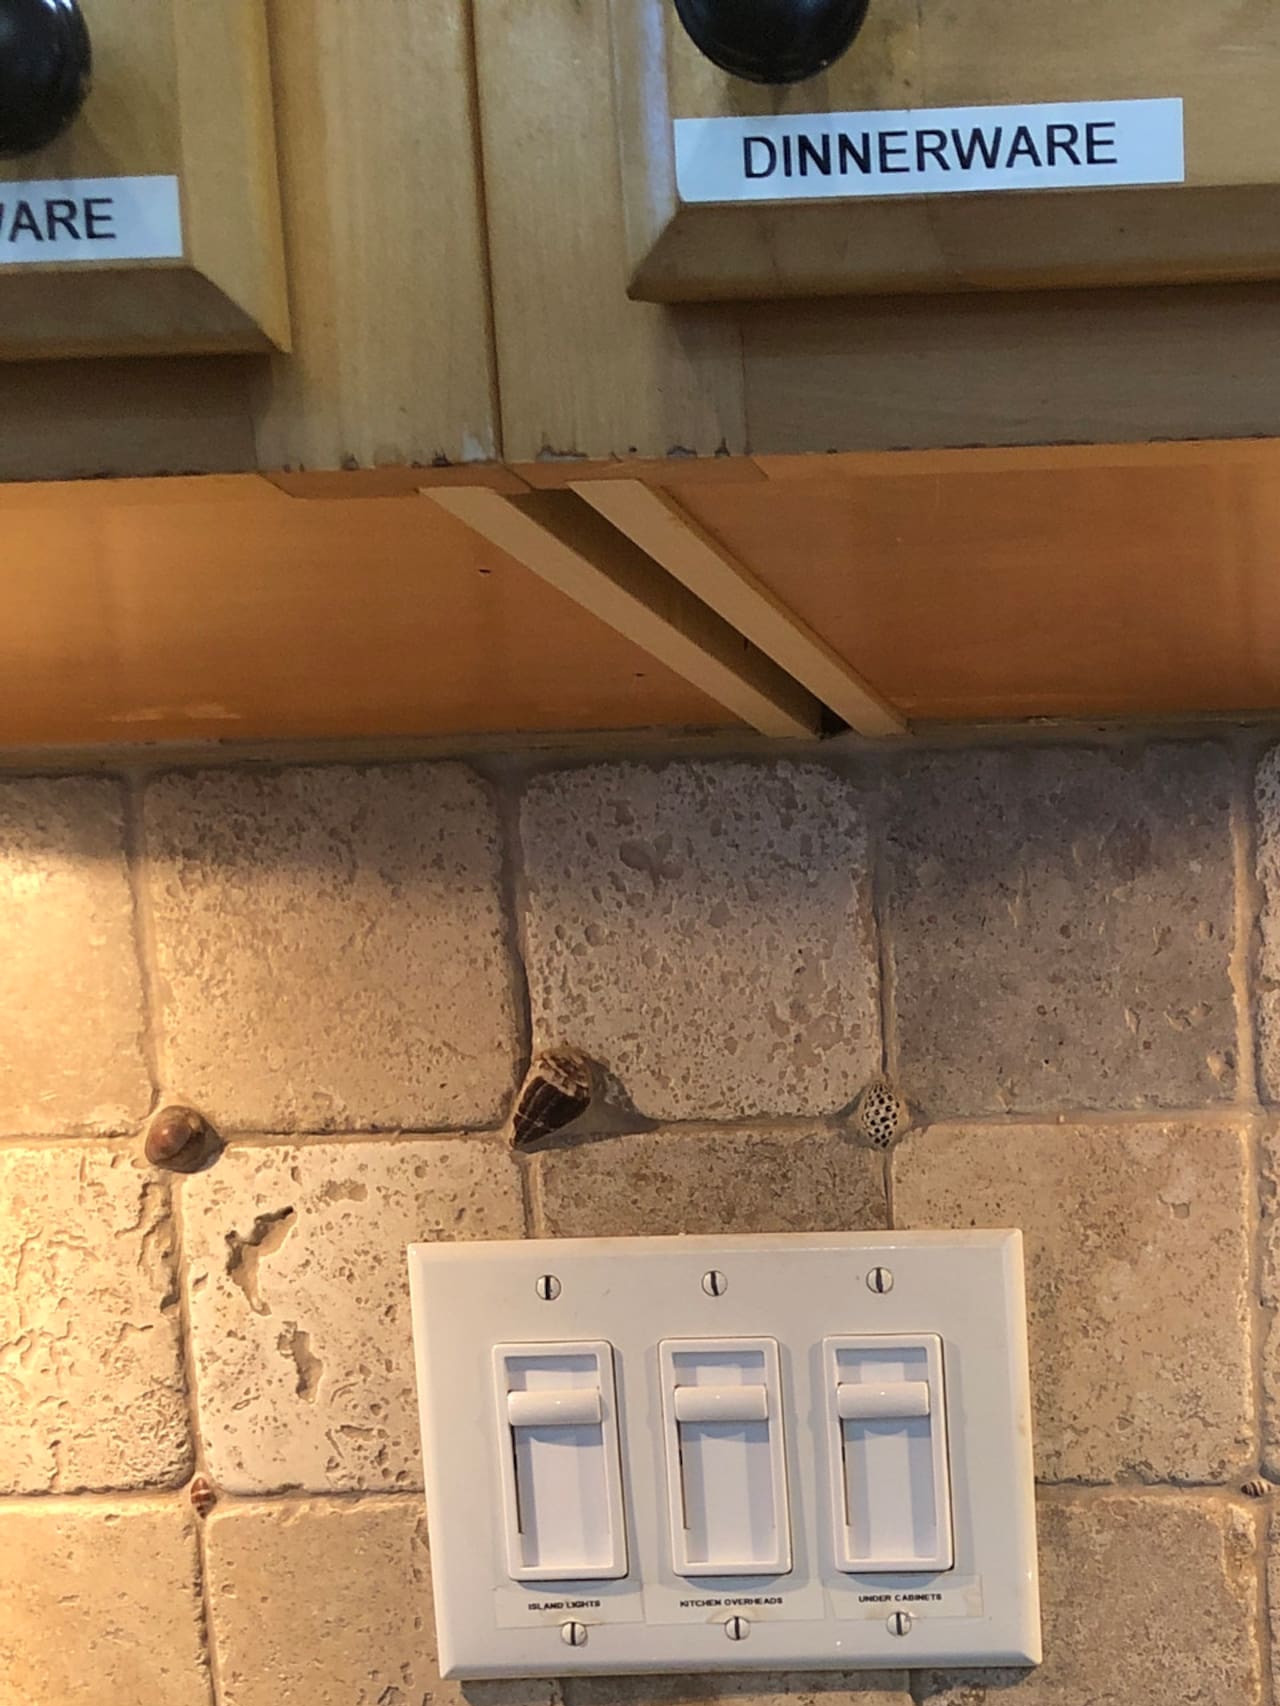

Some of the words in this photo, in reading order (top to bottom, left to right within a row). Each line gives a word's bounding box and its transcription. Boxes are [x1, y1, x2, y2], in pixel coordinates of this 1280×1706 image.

[742, 121, 1118, 181] DINNERWARE
[0, 197, 117, 243] ARE
[679, 1598, 722, 1608] KITCHEN
[723, 1596, 783, 1606] OVERHEADS
[858, 1594, 892, 1603] UNDER
[894, 1592, 943, 1602] CABINETS
[527, 1601, 564, 1611] ISLAND
[566, 1599, 601, 1609] LIGHTS
